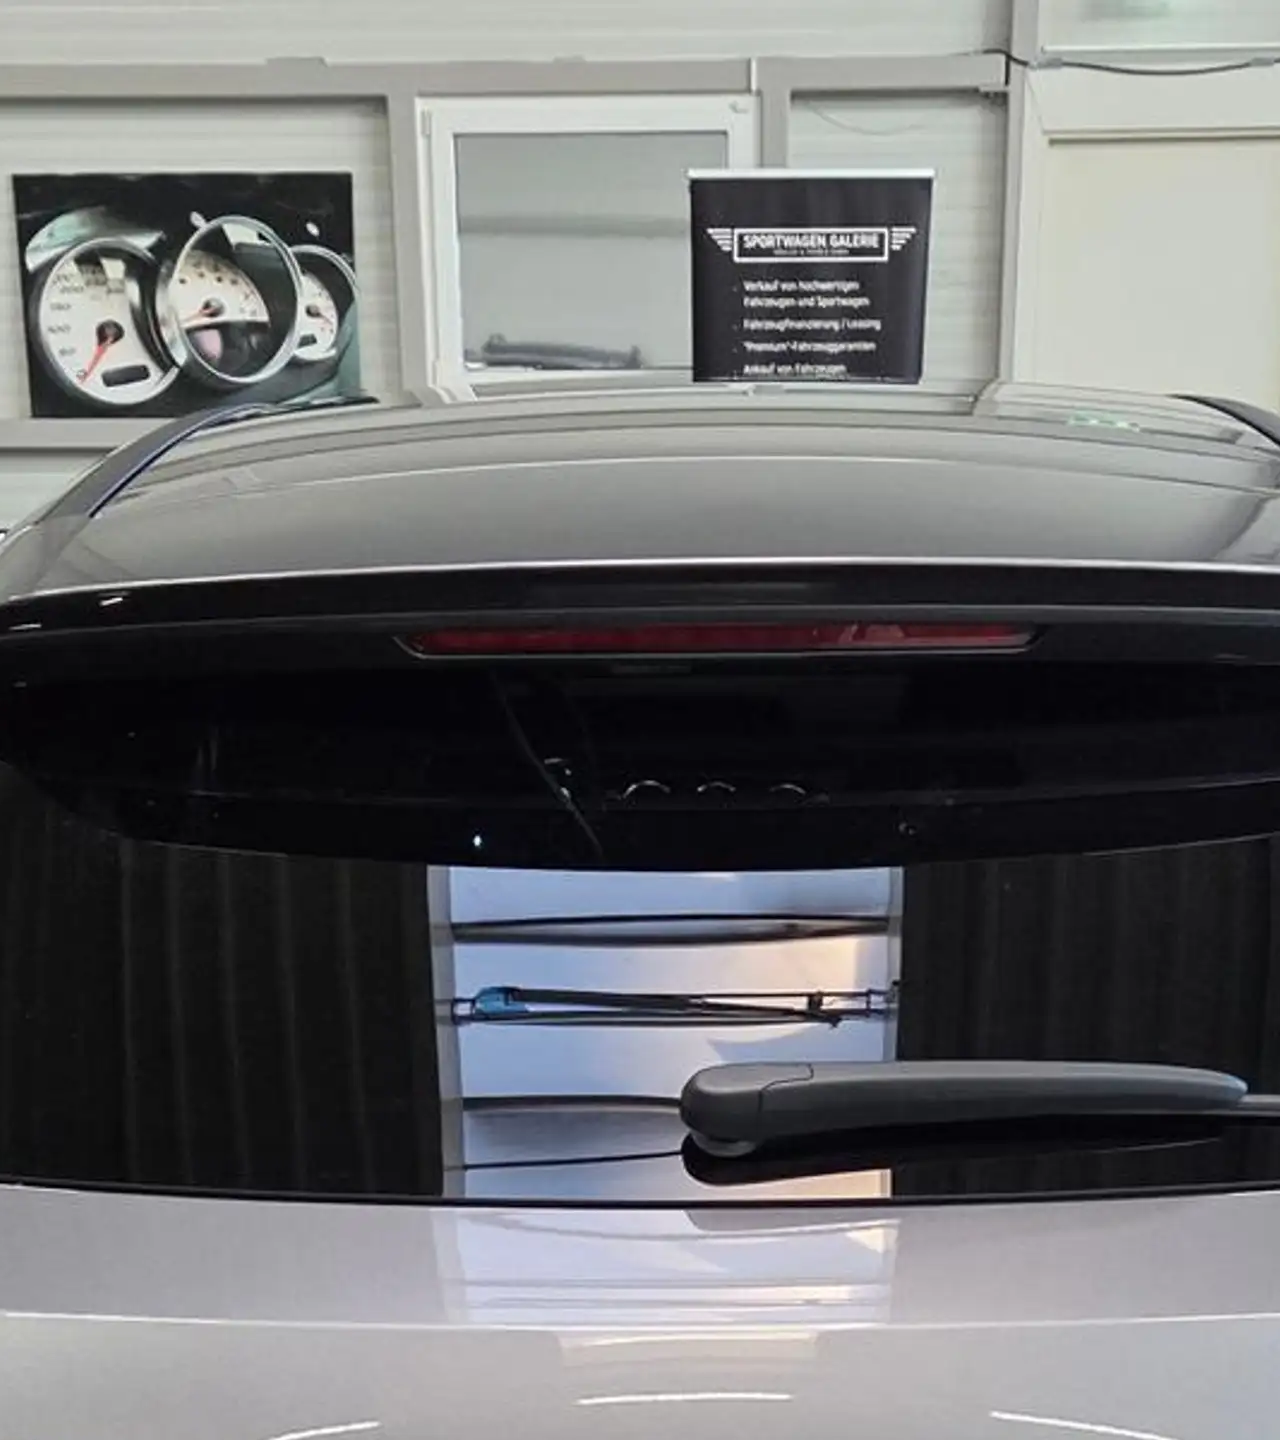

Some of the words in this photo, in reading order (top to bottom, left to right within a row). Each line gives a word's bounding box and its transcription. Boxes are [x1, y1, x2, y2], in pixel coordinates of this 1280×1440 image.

[743, 233, 826, 248] SPORTWAGEN
[830, 233, 879, 248] GALERIE
[743, 280, 778, 291] Verkauf
[781, 282, 797, 291] von
[743, 297, 795, 308] Fahrzeugen
[798, 297, 815, 307] und
[817, 296, 869, 308] Sportwagen
